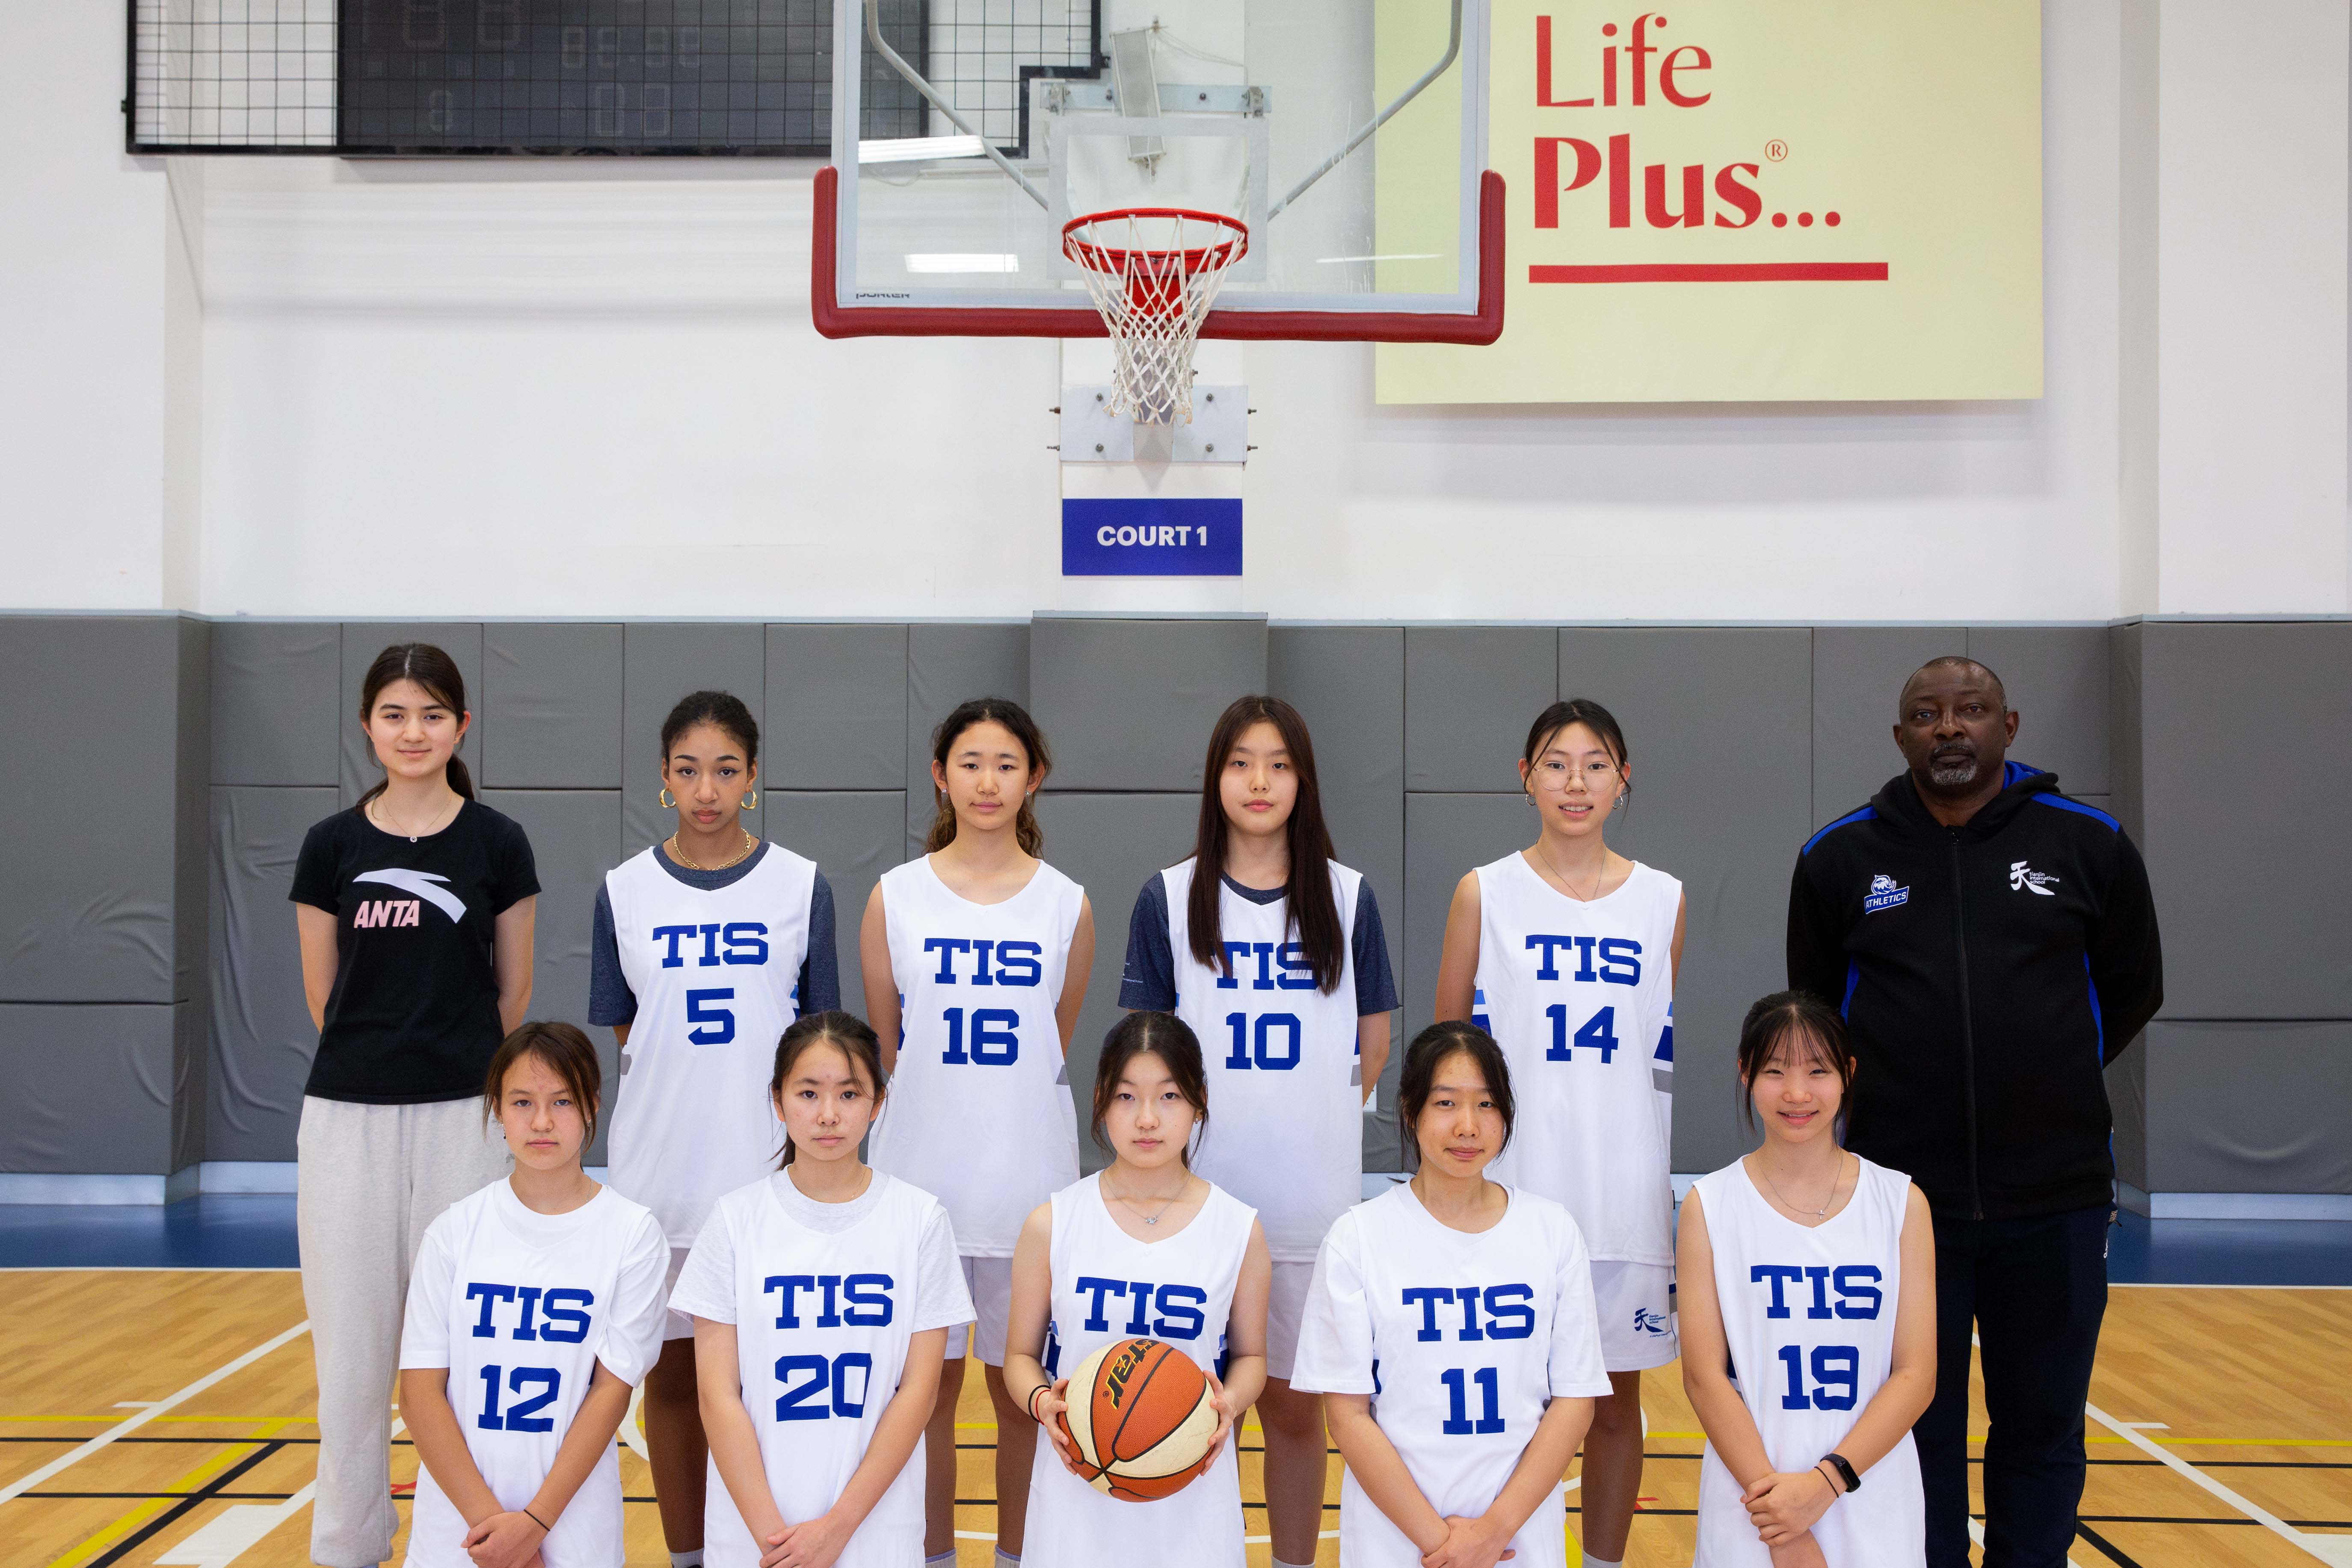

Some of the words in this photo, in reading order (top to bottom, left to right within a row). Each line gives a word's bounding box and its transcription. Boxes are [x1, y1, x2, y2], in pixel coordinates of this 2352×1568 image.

[1536, 12, 1712, 108] Life
[1096, 526, 1191, 547] COURT
[1196, 526, 1207, 546] 1
[353, 900, 420, 928] ANTA
[1866, 891, 1907, 909] ATHLETICS
[652, 922, 768, 968] TIS
[924, 938, 1042, 987] TIS
[1525, 935, 1642, 986] TIS
[686, 988, 735, 1045] 5
[942, 1008, 1019, 1066] 16
[1226, 1012, 1301, 1070] 10
[1546, 1004, 1619, 1064] 14
[466, 1283, 594, 1343] TIS
[764, 1273, 894, 1329] TIS
[1075, 1277, 1207, 1340] TIS
[1402, 1284, 1535, 1342] TIS
[1751, 1265, 1882, 1320] TIS
[478, 1364, 561, 1432] 12
[775, 1352, 872, 1422] 20
[1441, 1367, 1505, 1435] 11
[1778, 1345, 1859, 1411] 19
